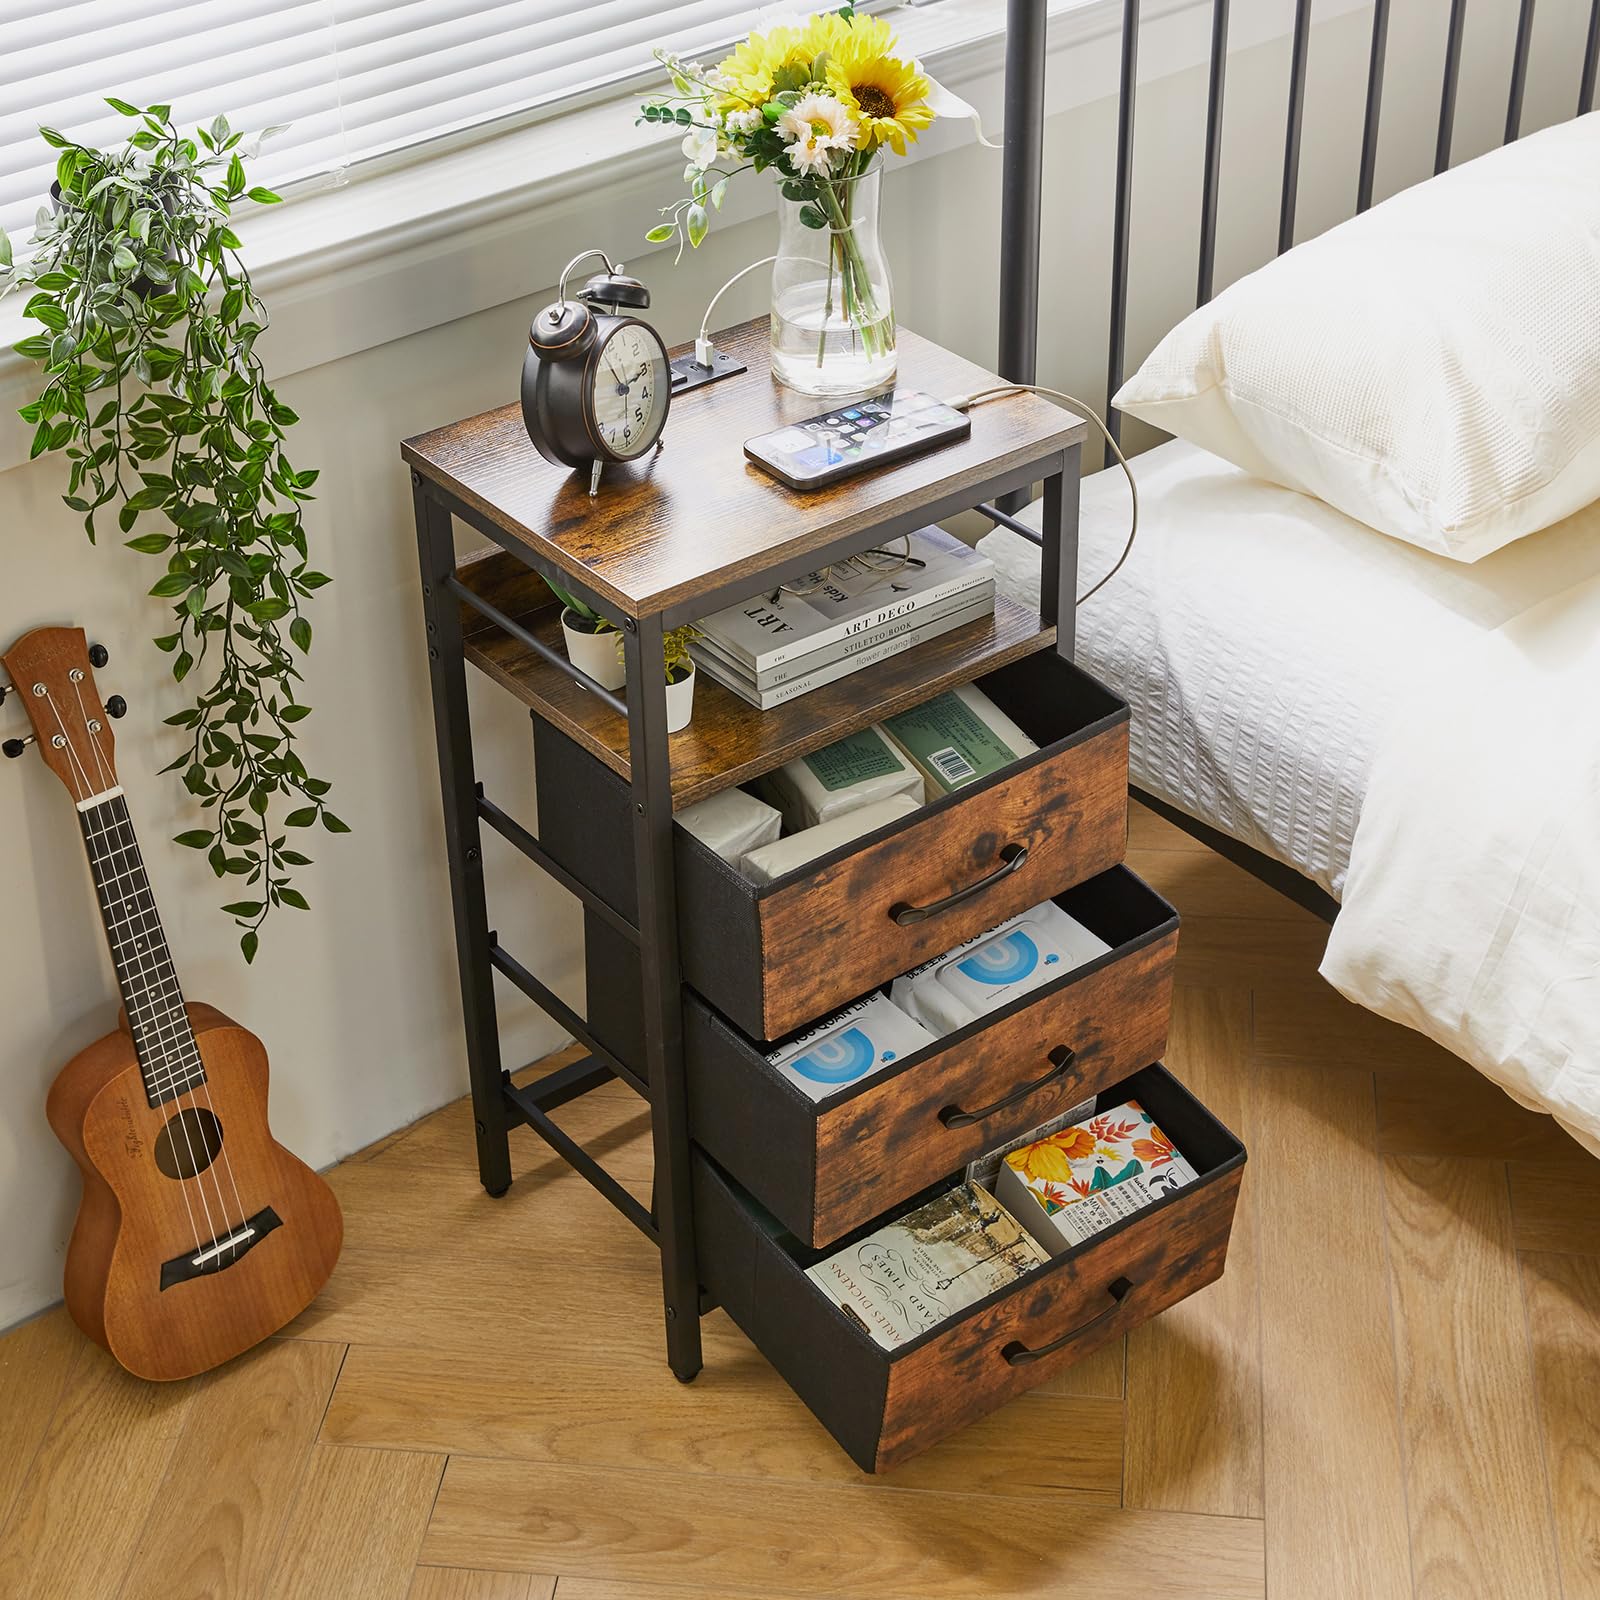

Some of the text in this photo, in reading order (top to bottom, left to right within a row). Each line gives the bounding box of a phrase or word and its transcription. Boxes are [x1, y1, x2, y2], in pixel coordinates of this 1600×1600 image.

[631, 342, 640, 357] 2
[640, 361, 648, 376] 3
[641, 386, 649, 400] 4
[634, 407, 643, 422] 5
[609, 428, 616, 443] 7
[623, 424, 631, 438] 6
[823, 585, 849, 603] Kids
[743, 607, 795, 634] ART
[843, 618, 871, 636] ART
[877, 601, 916, 623] DECO
[774, 621, 913, 682] THE STILETTO BOOK
[775, 680, 811, 699] SEASONAL
[856, 650, 881, 667] flower
[817, 1008, 852, 1030] QUAN
[852, 996, 879, 1012] LIFE
[1133, 1176, 1148, 1195] luckin
[830, 1262, 874, 1310] DICKENS
[872, 1254, 938, 1325] ARD TIMES
